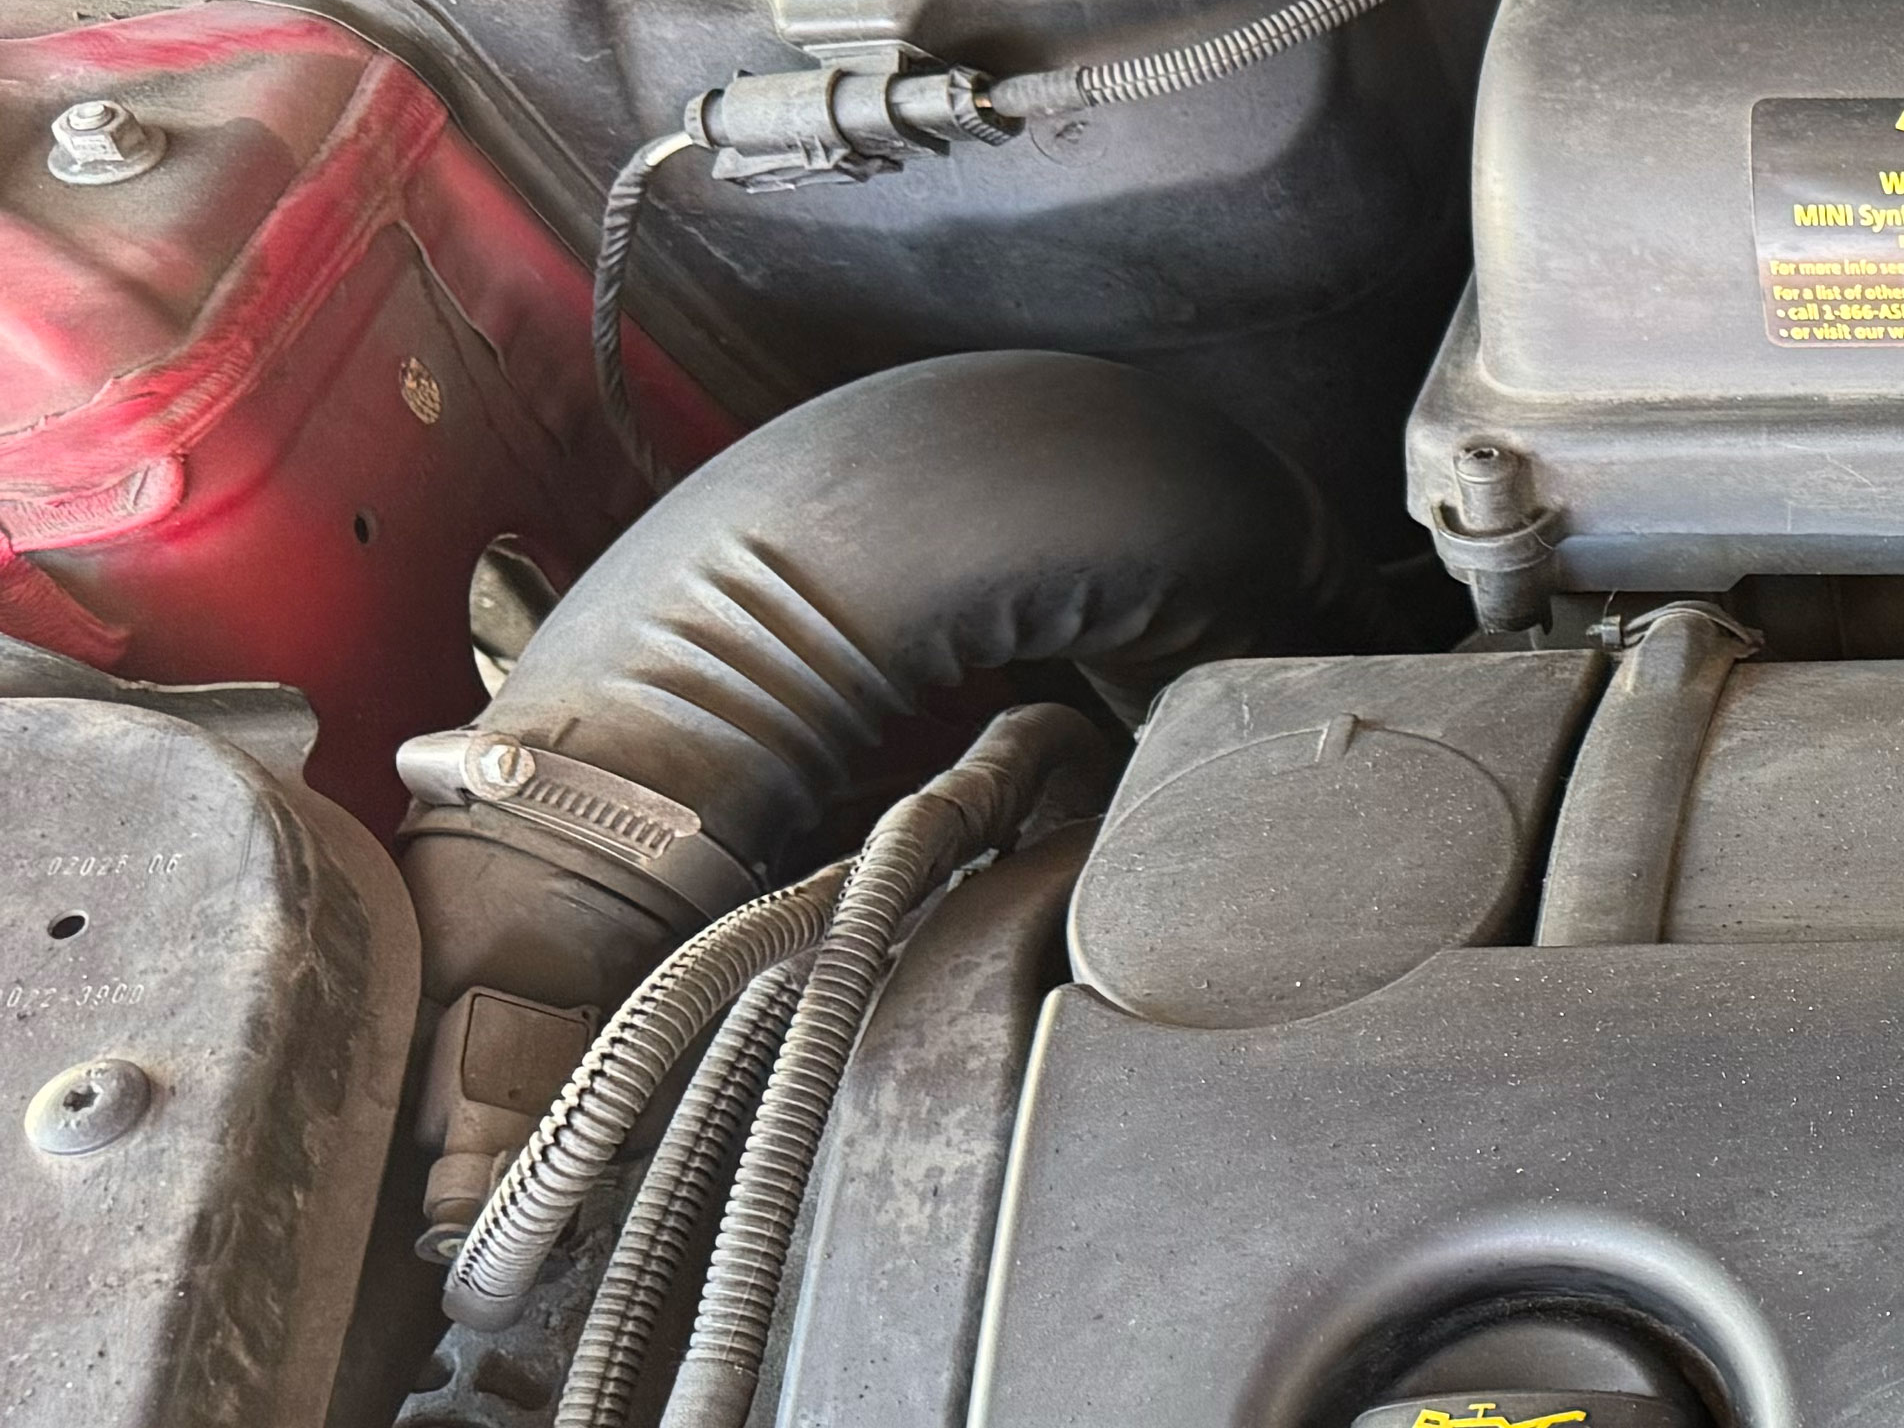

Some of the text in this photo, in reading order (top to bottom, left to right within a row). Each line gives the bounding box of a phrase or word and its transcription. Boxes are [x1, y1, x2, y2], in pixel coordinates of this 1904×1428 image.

[1793, 203, 1854, 227] MINI
[1769, 259, 1797, 276] For
[1799, 261, 1842, 276] more
[1843, 259, 1879, 276] info
[1772, 284, 1800, 301] For
[1803, 287, 1814, 301] a
[1815, 284, 1842, 301] list
[1843, 284, 1863, 300] of
[1787, 303, 1820, 321] call
[1790, 327, 1811, 340] or
[1812, 323, 1852, 340] visit
[1854, 327, 1886, 340] our
